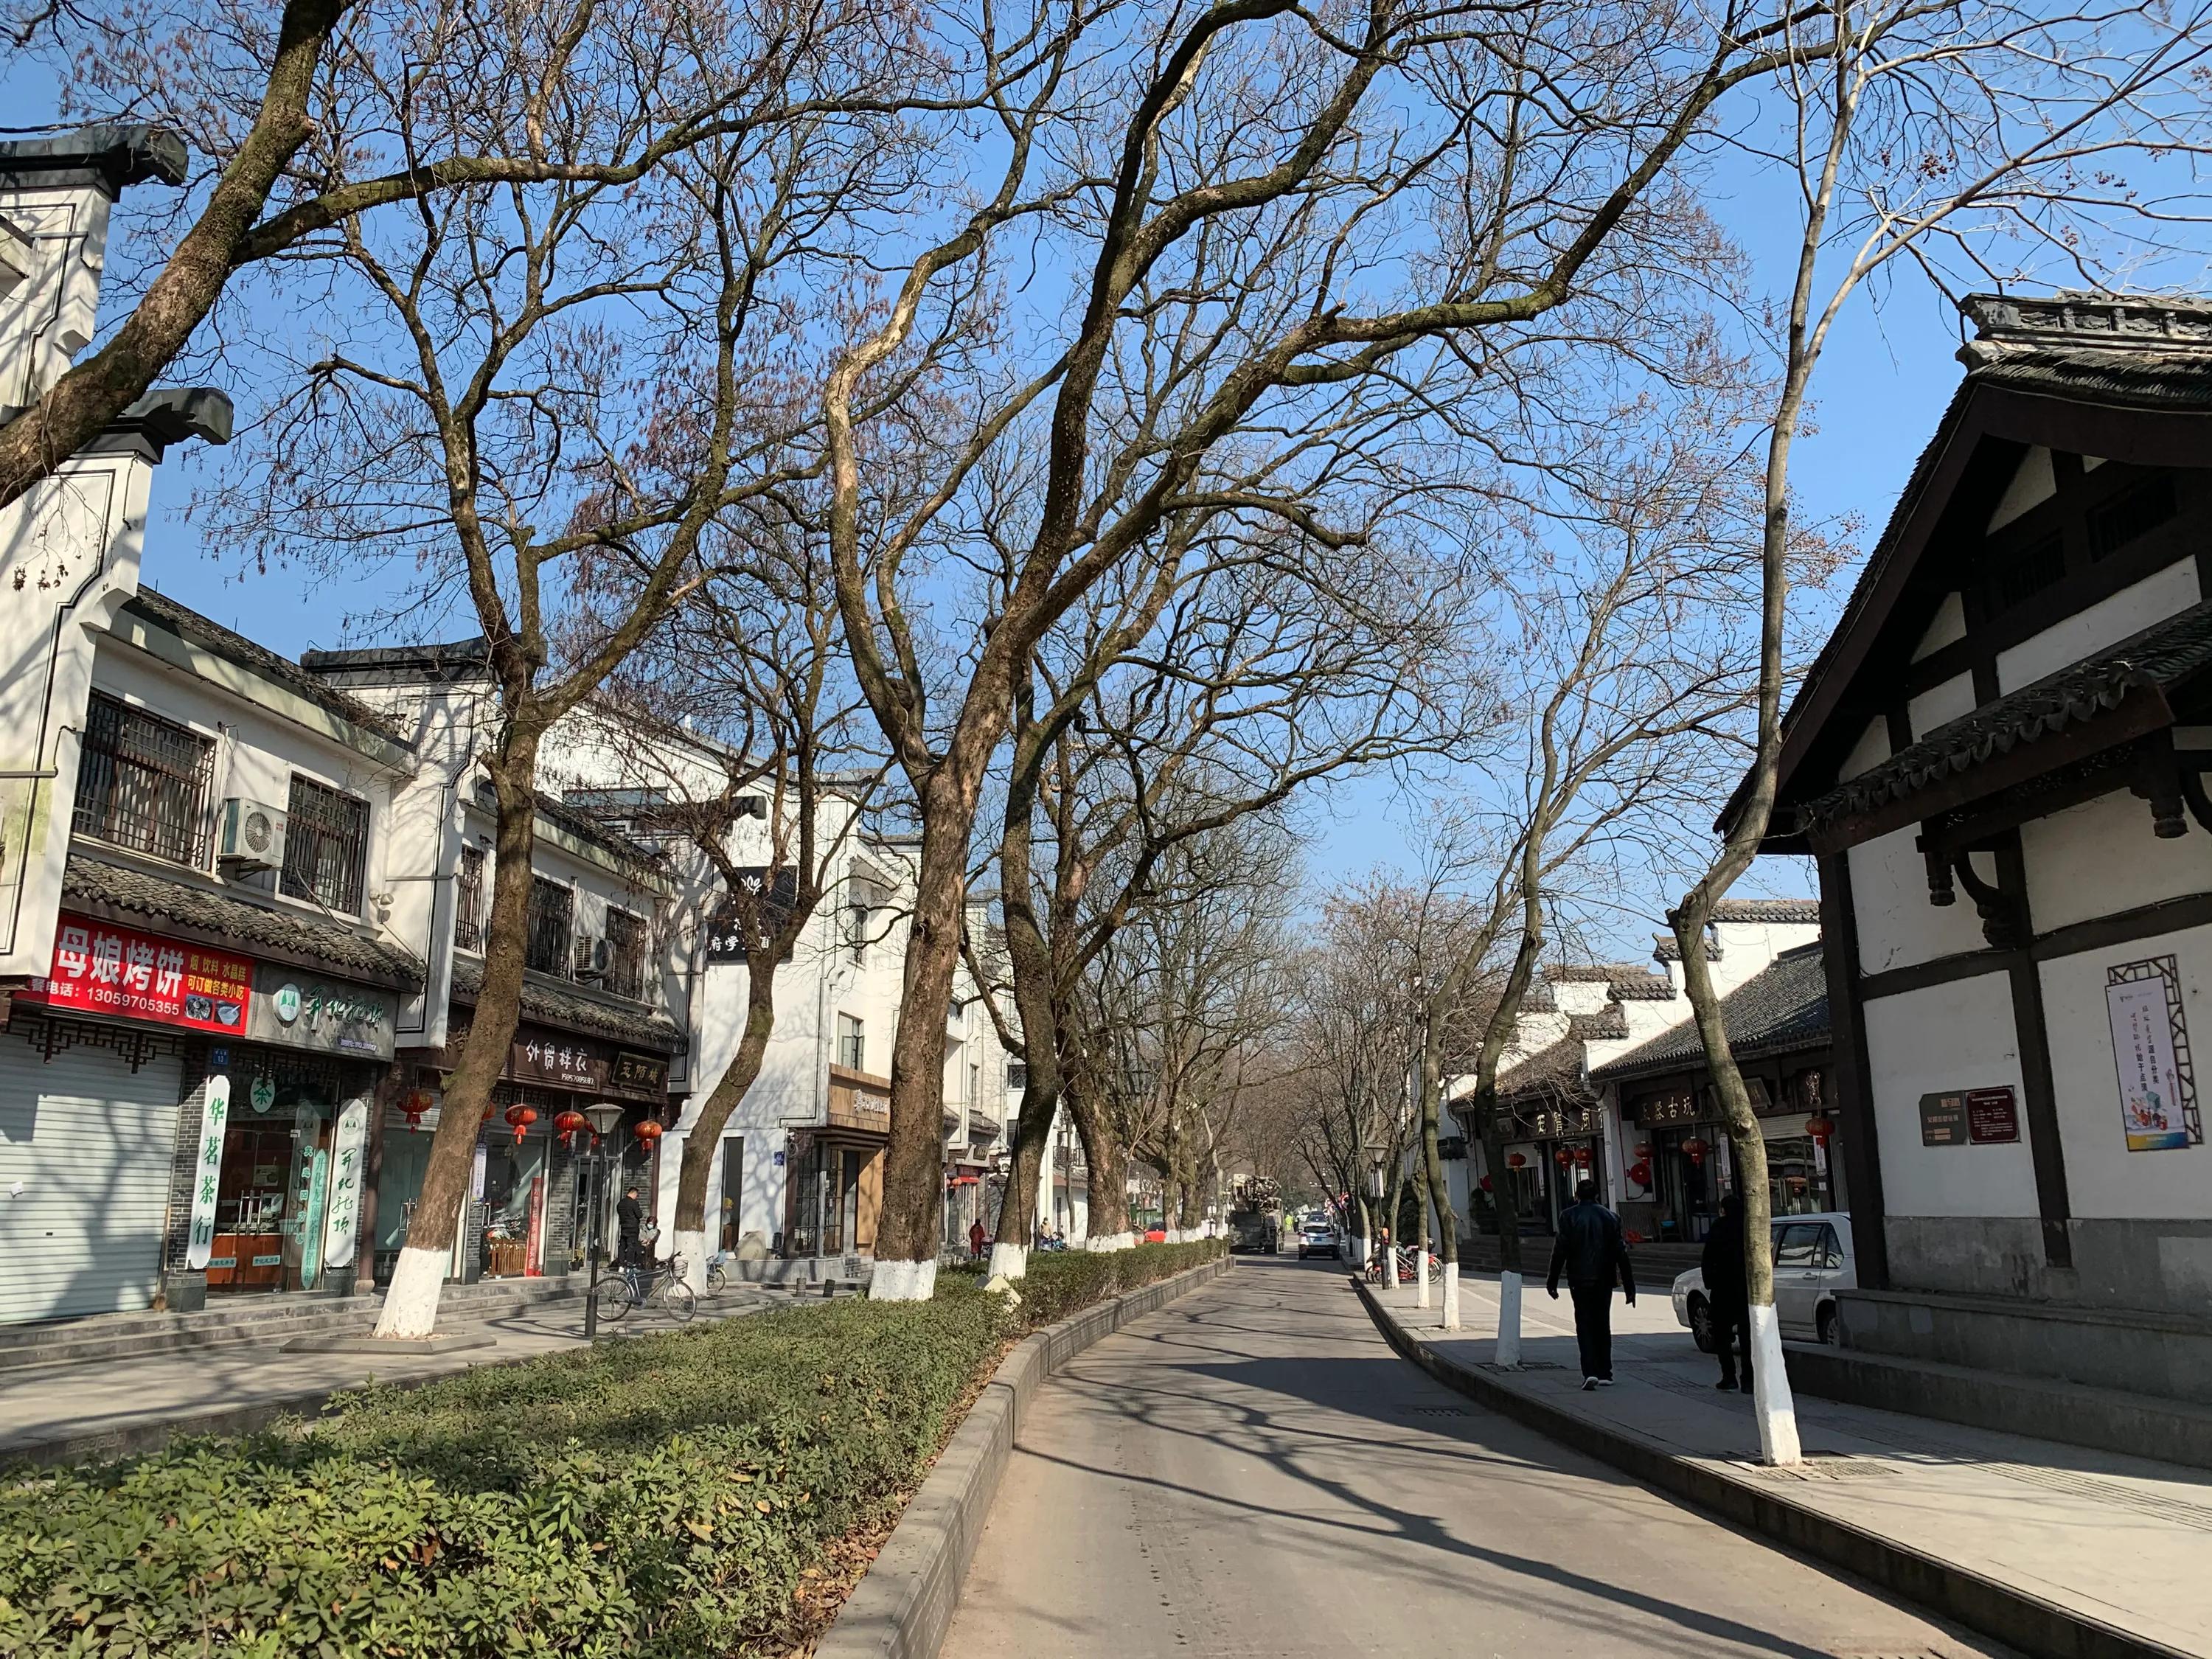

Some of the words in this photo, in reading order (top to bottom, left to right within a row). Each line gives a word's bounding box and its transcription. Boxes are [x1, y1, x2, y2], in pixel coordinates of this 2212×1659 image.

[58, 926, 184, 998] 母娘烤饼
[202, 957, 219, 976] 饮料
[222, 962, 247, 982] 水晶糕
[187, 974, 245, 1001] 可订做各类小吃
[253, 1079, 272, 1105] 茶
[195, 1097, 225, 1245] 华茗茶行
